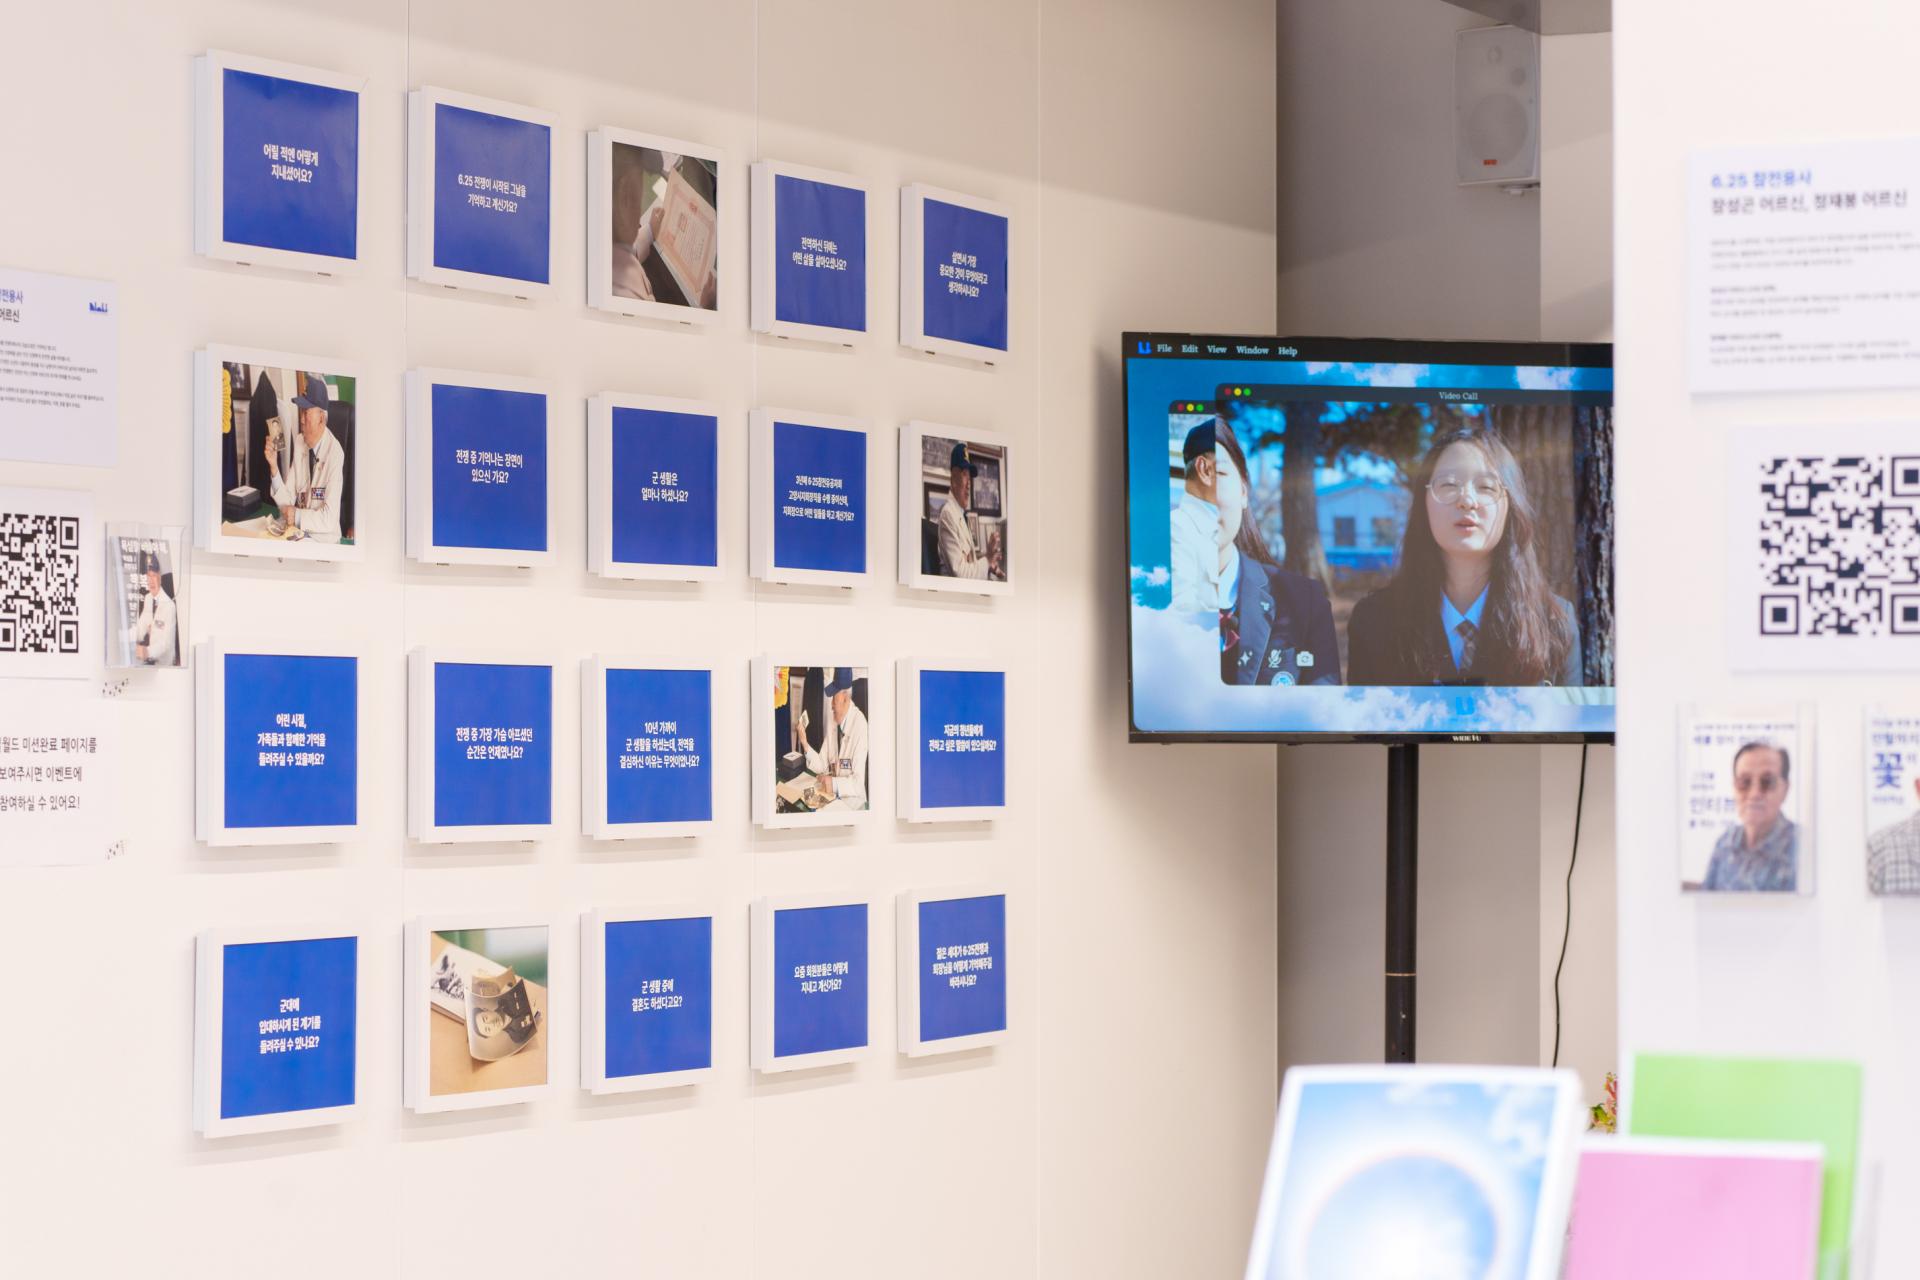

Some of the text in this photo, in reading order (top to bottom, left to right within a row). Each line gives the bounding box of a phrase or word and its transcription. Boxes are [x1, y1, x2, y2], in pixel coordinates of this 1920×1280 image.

[263, 143, 319, 167] 어릴 적엔 어떻게
[271, 164, 313, 183] 지내셨어요?
[458, 173, 527, 198] 6.25 전쟁이 시작된 그날을
[468, 193, 518, 213] 기억하고 계신가요?
[801, 236, 838, 255] 전역하신 뒤에는
[792, 251, 847, 271] 어떤 삶을 살아오셨나요?
[952, 251, 977, 268] 살면서 가장
[939, 263, 954, 279] 중요한
[0, 288, 23, 304] 전용사
[948, 281, 980, 298] 생각하시나요?
[1157, 344, 1298, 357] File Edit View Window Help
[1438, 391, 1479, 401] Video Call
[456, 449, 523, 469] 전쟁 중 기억나는 장면이
[471, 468, 509, 484] 있으신 가요?
[652, 471, 678, 486] 군 생활은
[641, 487, 689, 503] 얼마나 하셨나요?
[276, 711, 307, 729] 어린 시절,
[644, 721, 677, 735] 10년 가까이
[456, 727, 533, 742] 전쟁 중 가장 가슴 아프셨던
[943, 723, 959, 737] 지금의
[0, 736, 97, 754] 월드 미션완료 페이지를
[257, 731, 326, 748] 가족들과 함께한 기억을
[625, 738, 633, 752] 군
[633, 738, 651, 752] 생활을
[677, 738, 695, 752] 전역을
[928, 739, 945, 752] 전하고
[258, 751, 325, 767] 들려주실 수 있을까요?
[466, 745, 524, 760] 순간은 언제였나요?
[619, 755, 700, 769] 결심하신 이유는 무엇이었나요?
[45, 766, 83, 782] 이벤트에
[38, 796, 47, 811] 수
[49, 795, 80, 811] 있어요!
[794, 965, 806, 979] 요즘
[832, 961, 849, 975] 어떻게
[953, 959, 969, 974] 어떻게
[641, 978, 674, 994] 군 생활 중에
[801, 978, 842, 995] 지내고 계신가요?
[949, 974, 977, 989] 바라시나요?
[280, 997, 300, 1013] 군대에
[631, 995, 683, 1012] 결혼도 하셨다고요?
[258, 1015, 321, 1035] 입대하시게 된 계기를
[260, 1035, 320, 1055] 들려주실 수 있나요?
